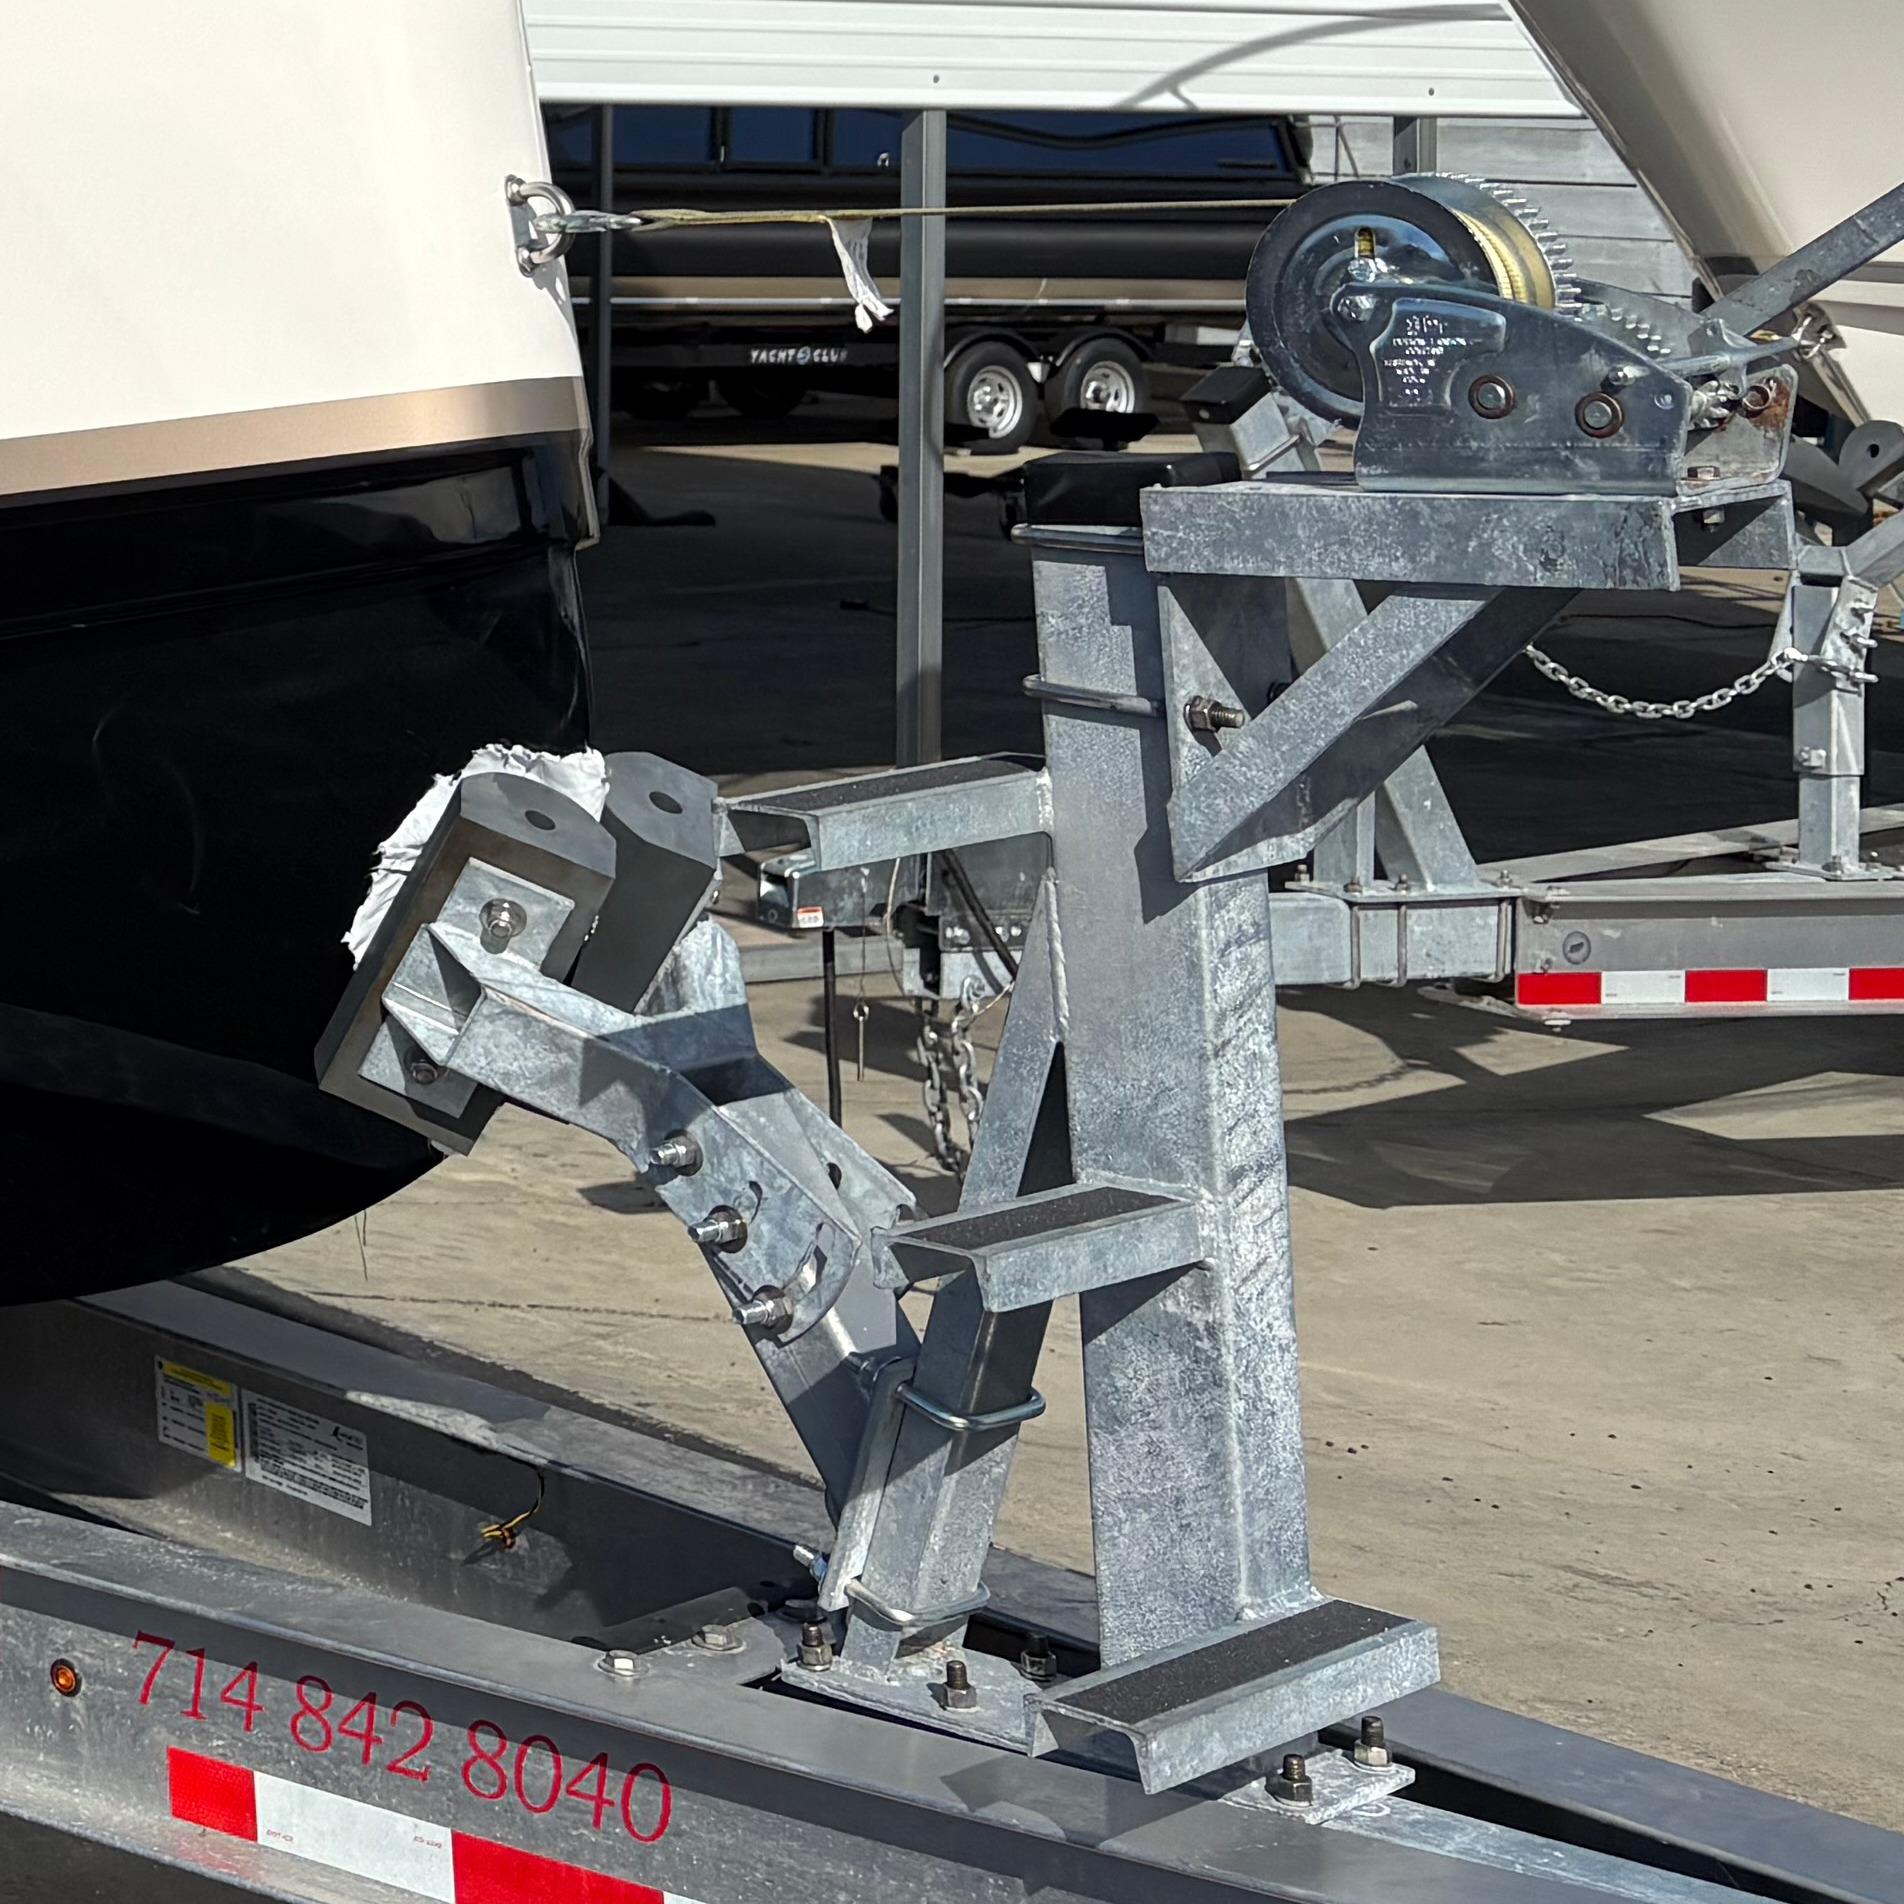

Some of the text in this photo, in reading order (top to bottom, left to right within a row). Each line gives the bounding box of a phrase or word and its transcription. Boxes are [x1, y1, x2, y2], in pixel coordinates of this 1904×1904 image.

[750, 348, 796, 364] YACHT
[132, 1630, 673, 1844] 714 842 8040
